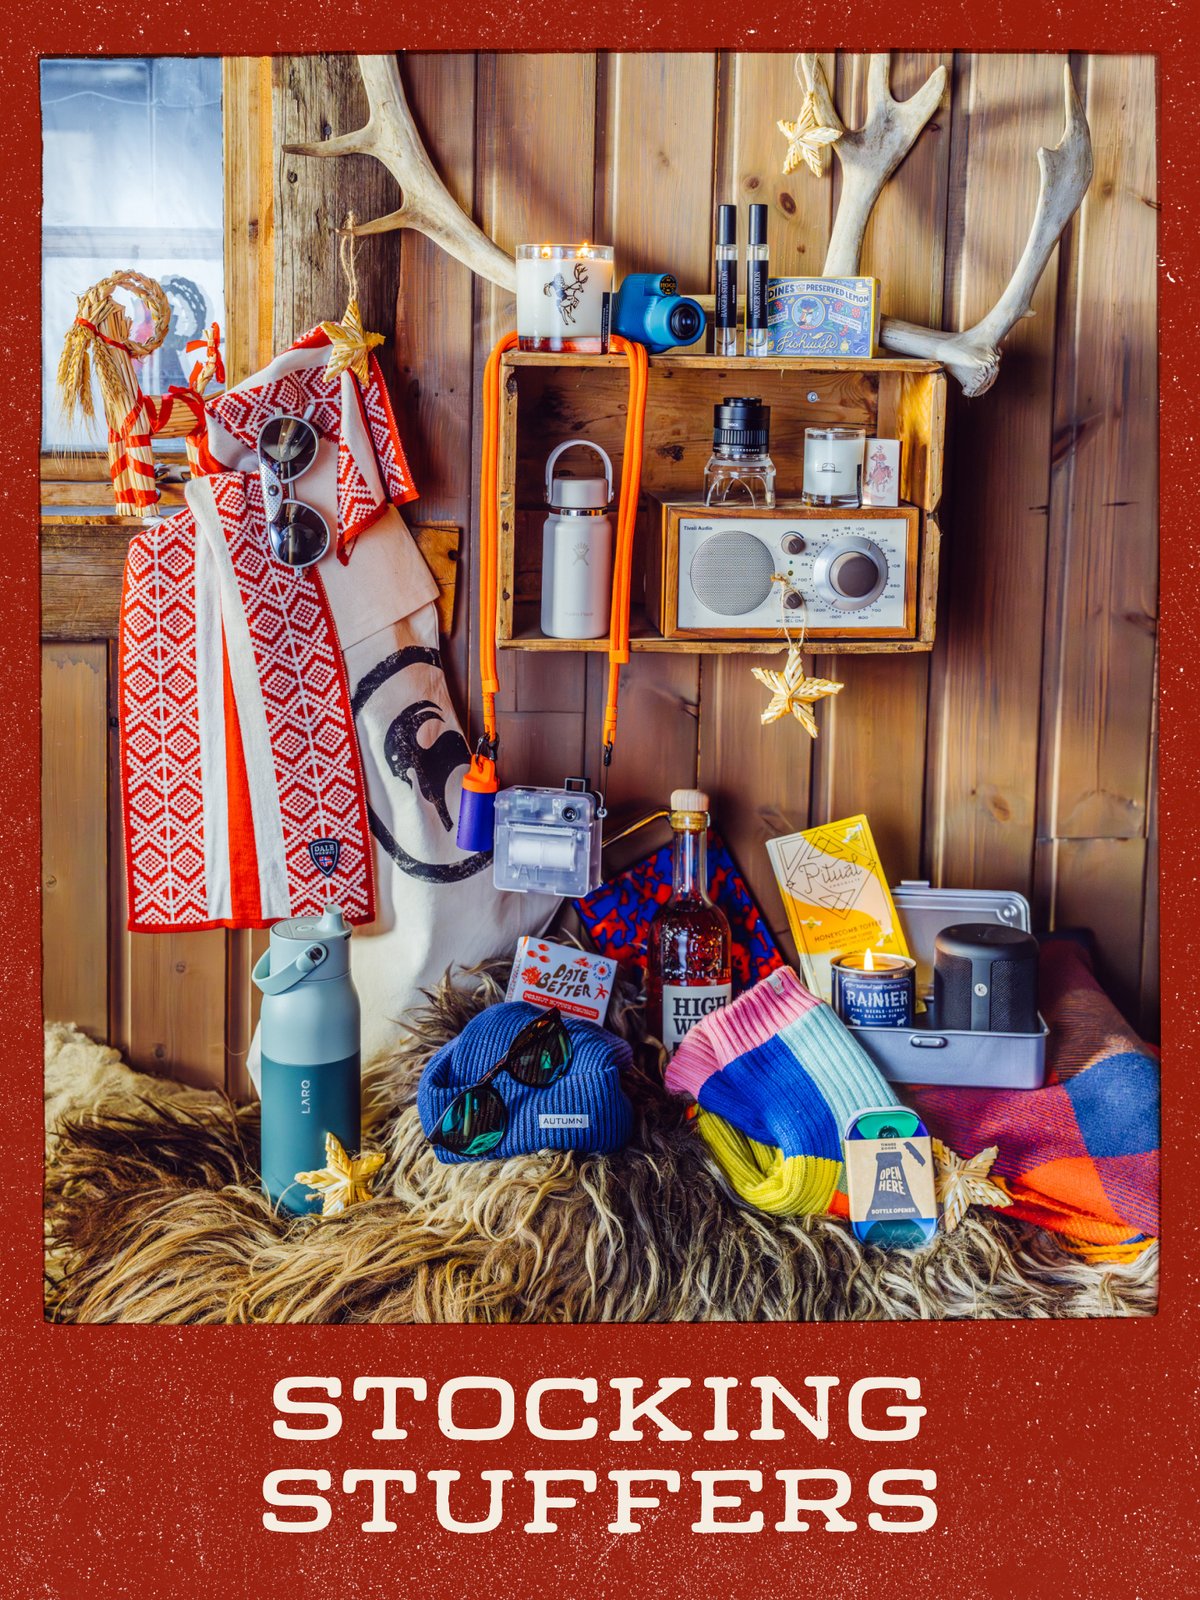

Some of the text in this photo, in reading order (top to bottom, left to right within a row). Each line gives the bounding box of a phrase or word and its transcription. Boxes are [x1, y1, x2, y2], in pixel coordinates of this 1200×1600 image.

[720, 270, 729, 318] RANGER STATION
[753, 271, 761, 319] RANGER STATION
[768, 284, 795, 299] DINES
[806, 283, 845, 296] PRESERVED
[845, 291, 870, 303] LEMON
[314, 844, 335, 852] DALE
[798, 853, 863, 895] Ritual
[814, 926, 858, 942] HONEYCOMB
[553, 963, 588, 983] DATE
[535, 972, 592, 998] BETTER
[673, 995, 728, 1017] HIGH
[846, 990, 909, 1008] RAINIER
[301, 1079, 311, 1114] LARQ
[543, 1117, 583, 1125] AUTUMN
[880, 1165, 902, 1181] OPEN
[878, 1180, 906, 1196] HERE
[871, 1207, 893, 1215] BOTTLE
